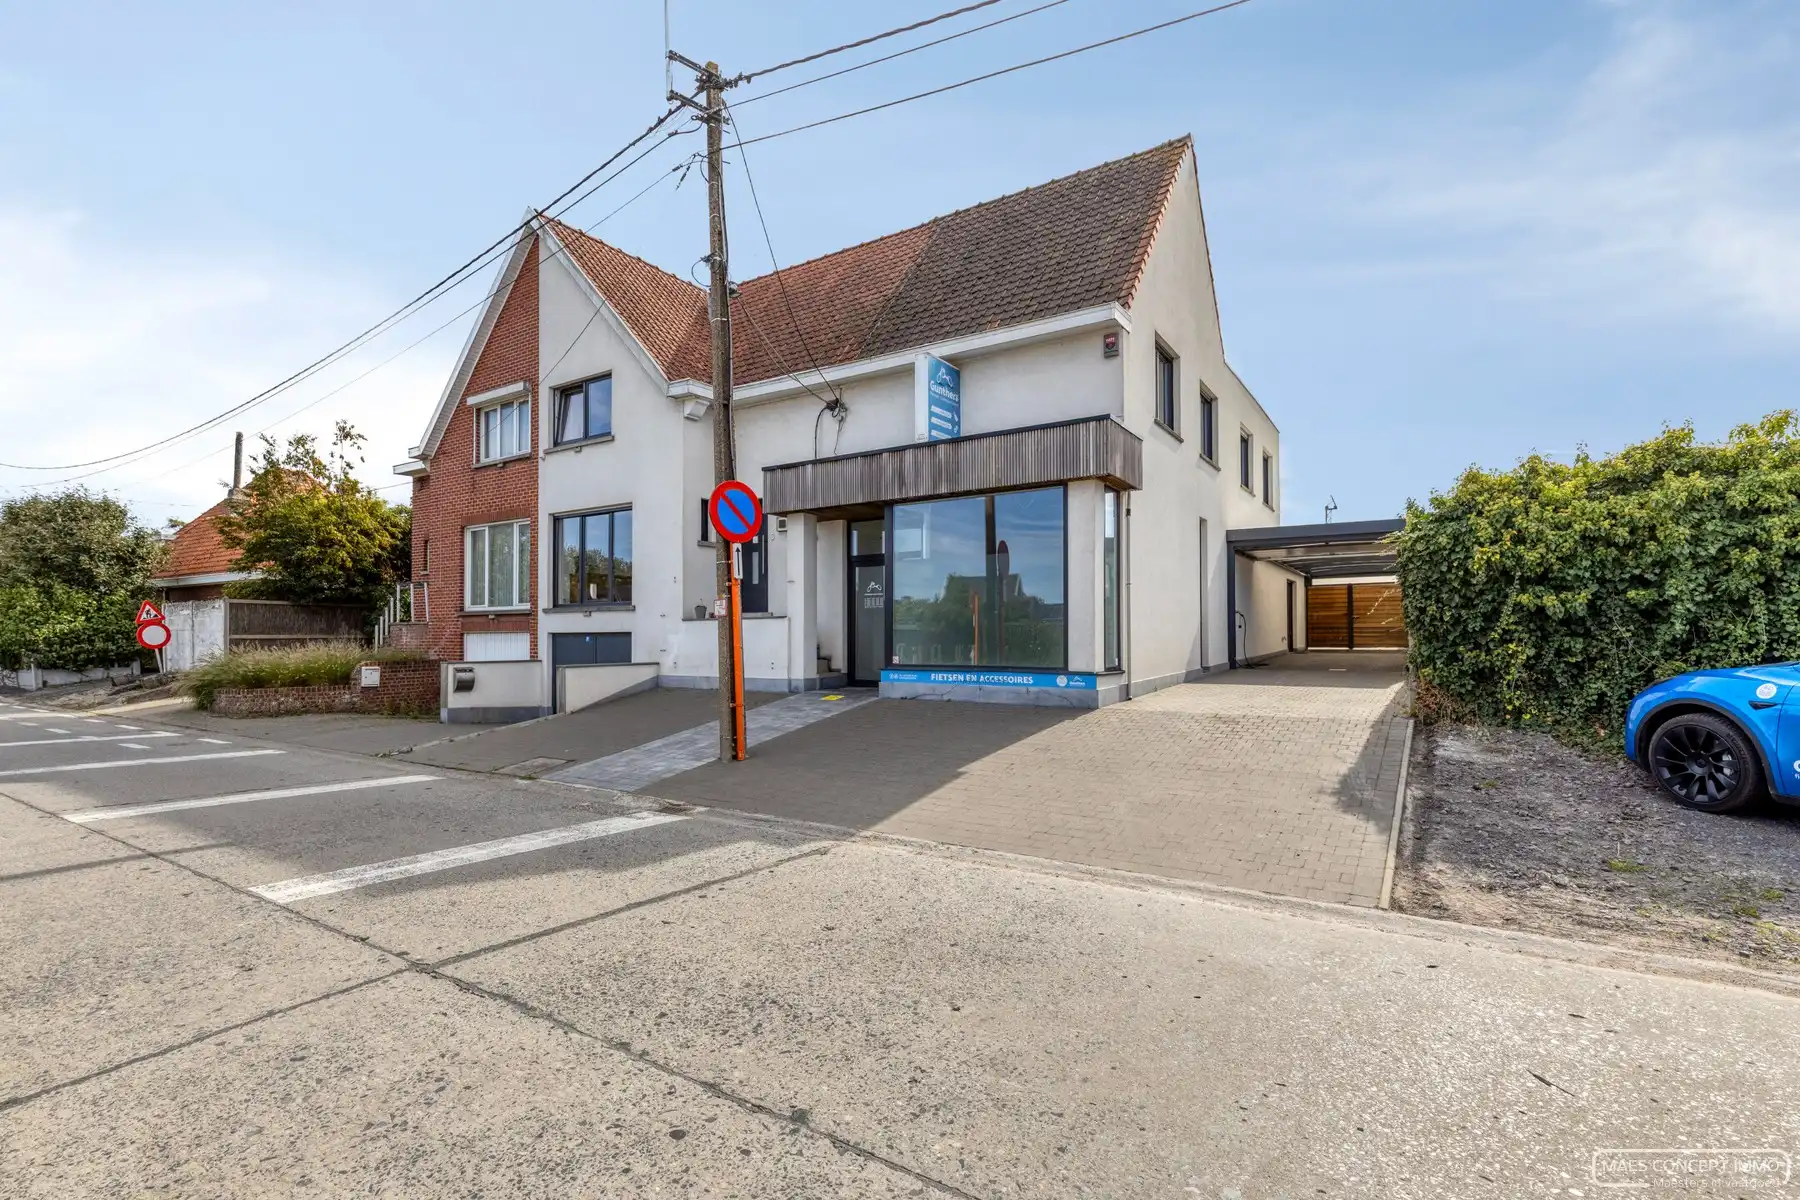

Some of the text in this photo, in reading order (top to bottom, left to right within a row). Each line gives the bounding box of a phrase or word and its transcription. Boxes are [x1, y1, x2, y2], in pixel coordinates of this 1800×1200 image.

[931, 673, 1033, 684] FIETSEN EN ACCESSOIRES
